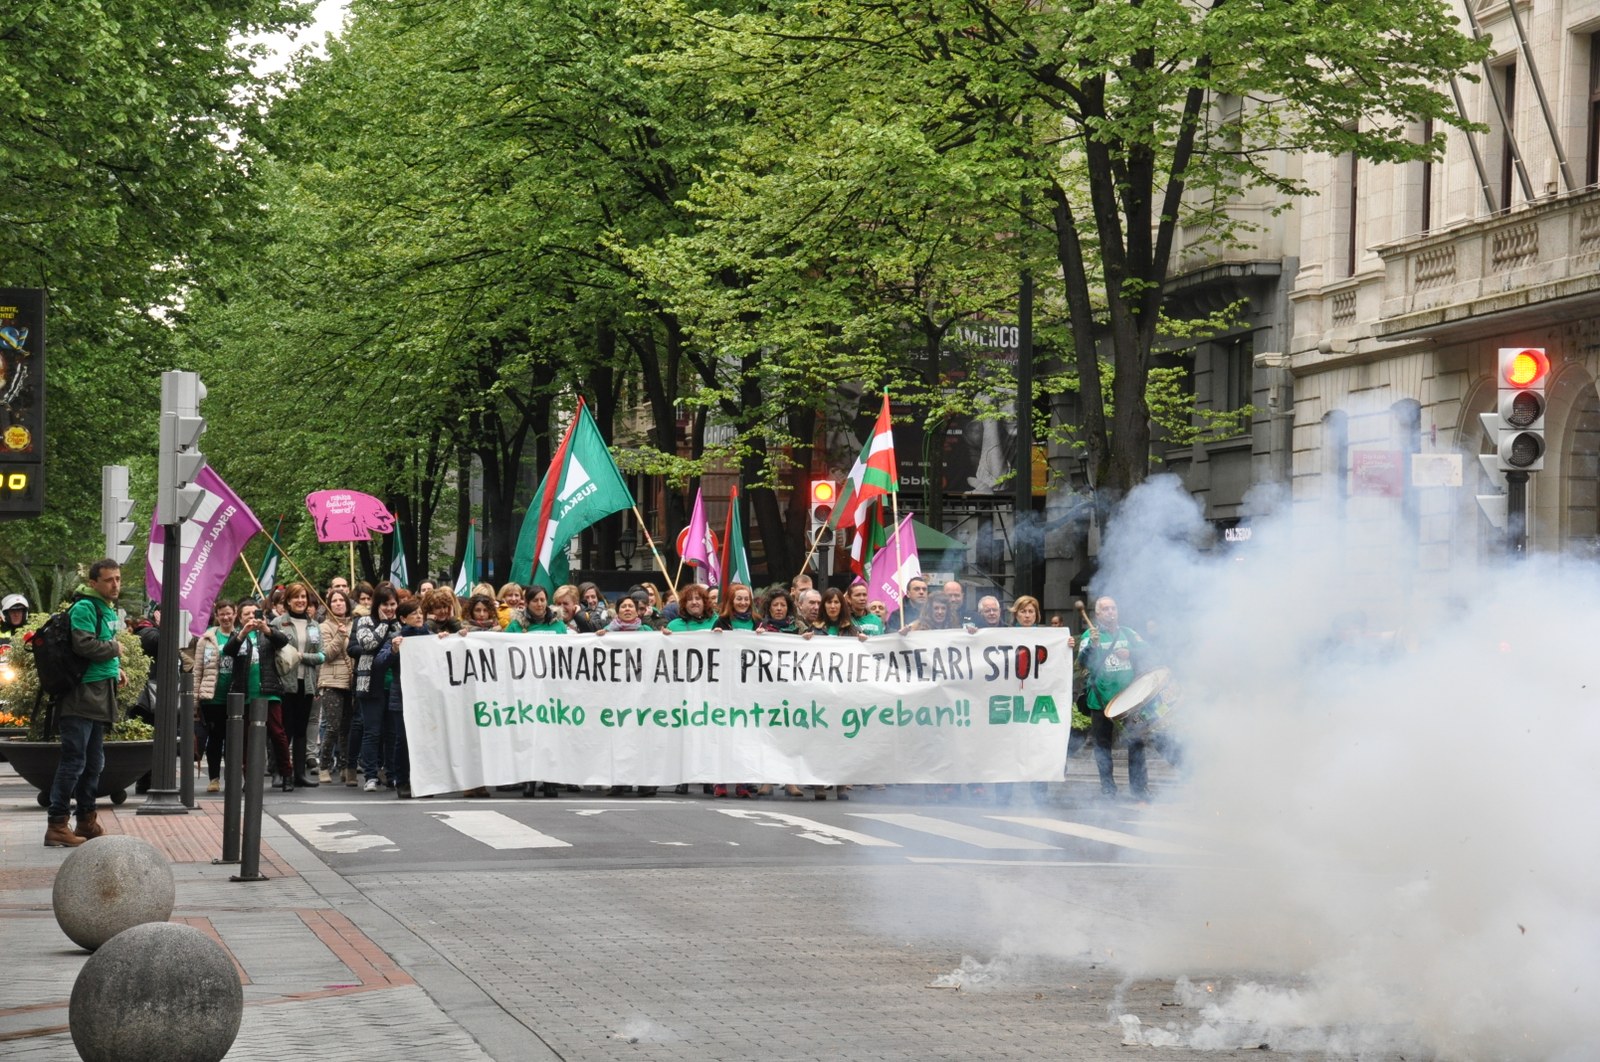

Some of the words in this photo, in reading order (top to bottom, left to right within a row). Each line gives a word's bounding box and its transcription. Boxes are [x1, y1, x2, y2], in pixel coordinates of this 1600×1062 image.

[901, 476, 930, 486] bbk
[446, 648, 498, 686] LAN
[508, 646, 642, 682] DUINAREN
[654, 648, 720, 683] ALDE
[740, 646, 974, 683] PREKARIETATEARI
[983, 644, 1048, 684] STOP
[474, 698, 586, 727] Bizkaiko
[600, 700, 828, 729] erresidentziak
[841, 699, 970, 738] greban!!
[988, 695, 1060, 724] ELA
